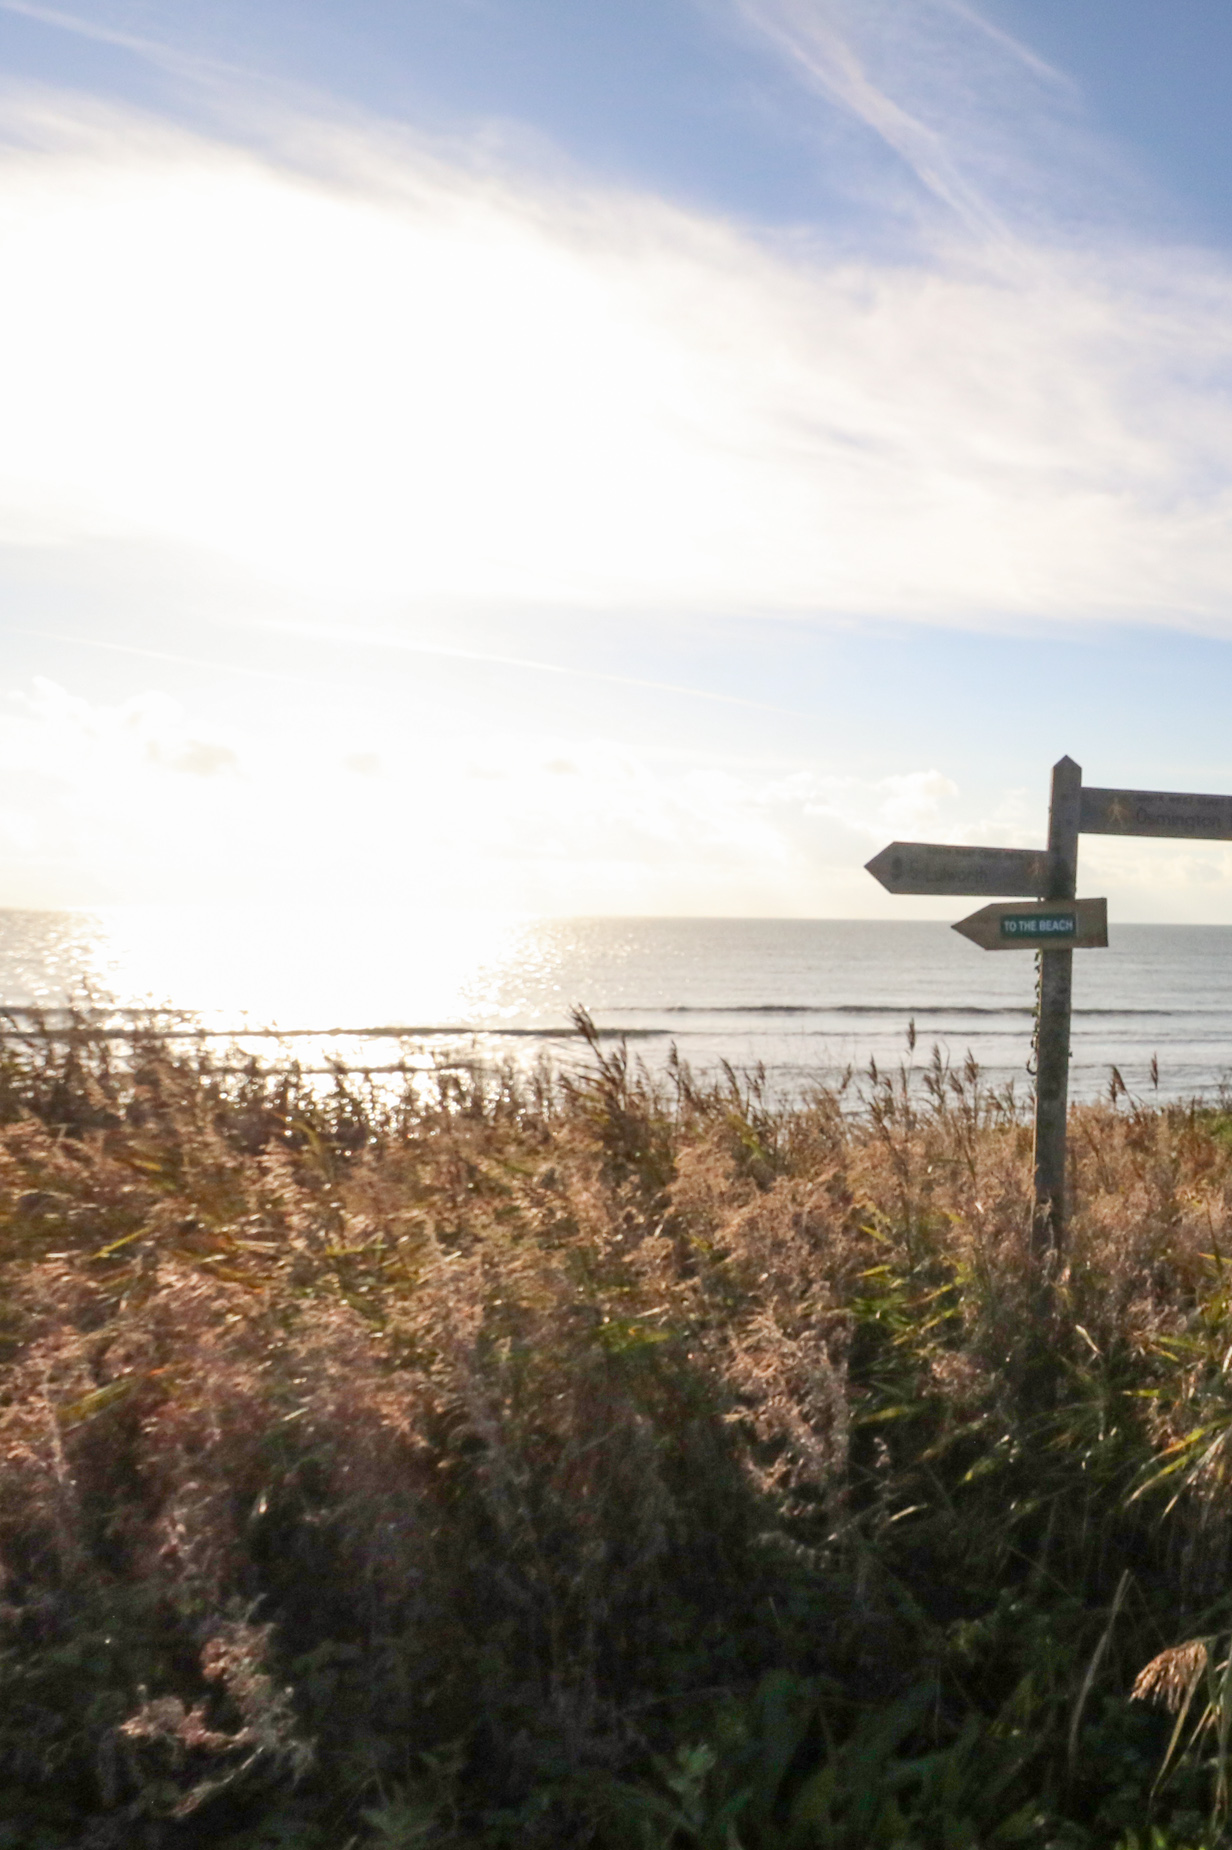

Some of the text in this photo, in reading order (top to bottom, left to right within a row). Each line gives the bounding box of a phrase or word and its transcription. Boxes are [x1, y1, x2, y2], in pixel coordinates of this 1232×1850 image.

[1135, 807, 1221, 833] Osmington
[925, 862, 988, 883] Lulworth
[1004, 919, 1073, 932] TO THE BEACH
